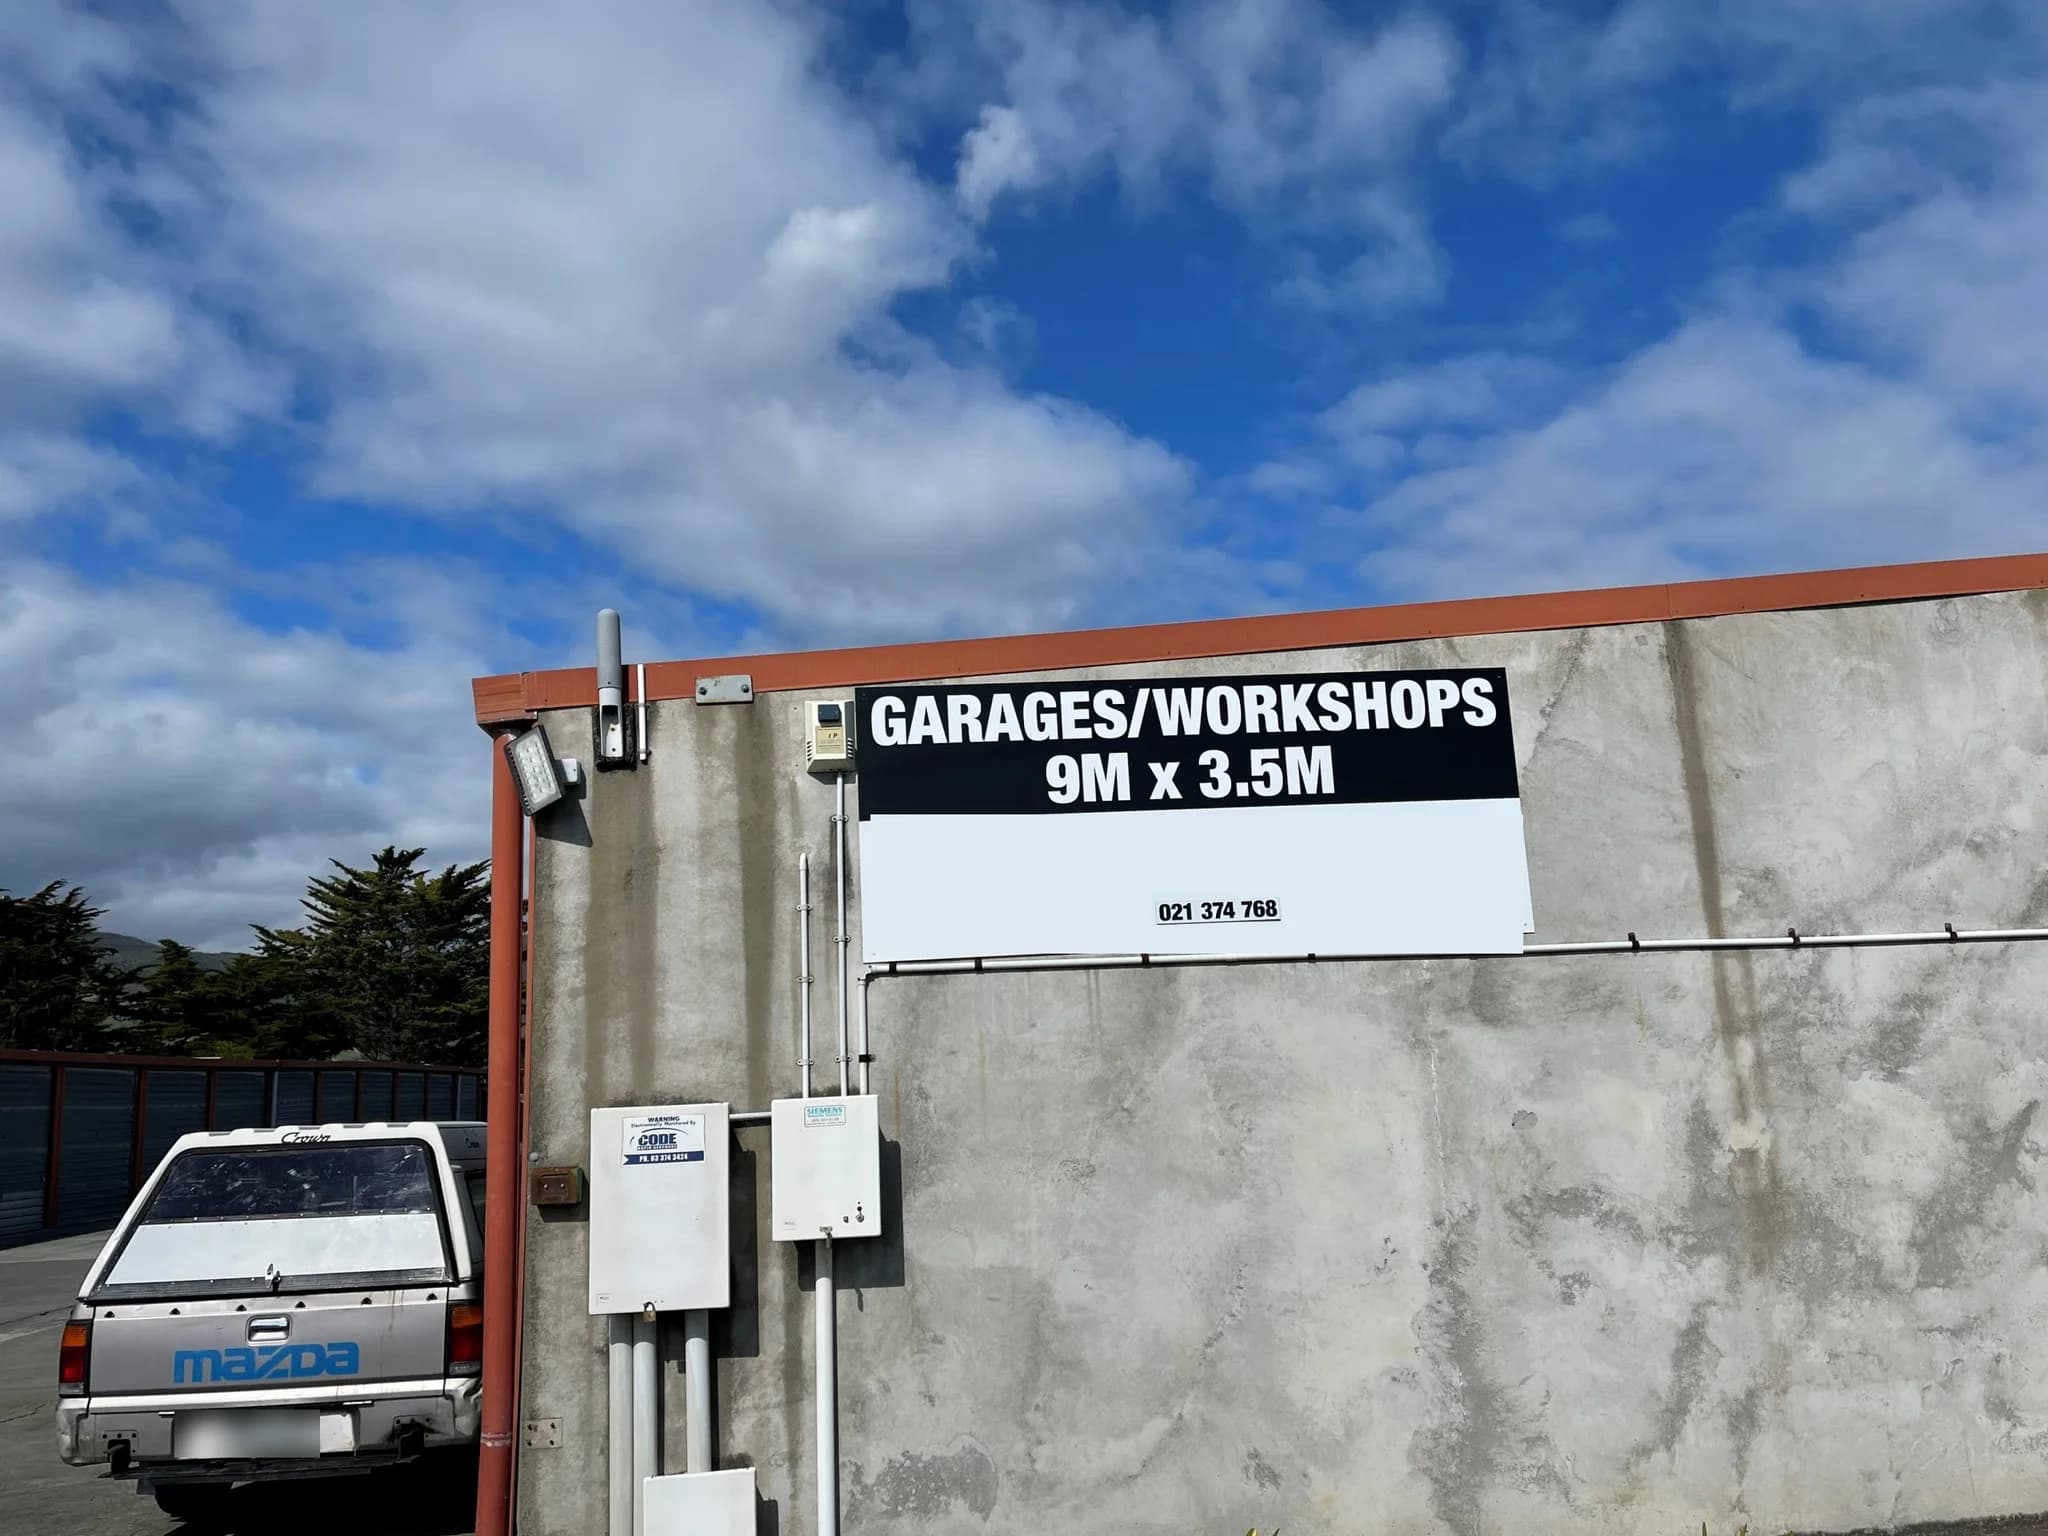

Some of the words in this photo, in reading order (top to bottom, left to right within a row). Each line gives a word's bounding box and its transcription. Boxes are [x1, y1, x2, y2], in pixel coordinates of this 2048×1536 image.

[870, 677, 1498, 747] GARAGES/WORKSHOPS
[1045, 754, 1131, 804] 9M
[1198, 745, 1335, 799] 3.5M
[1158, 903, 1192, 921] 021
[1200, 902, 1236, 920] 374
[1240, 899, 1278, 918] 768
[807, 1106, 843, 1115] SIEMENS
[281, 1131, 331, 1144] Crown
[638, 1133, 677, 1145] CODE
